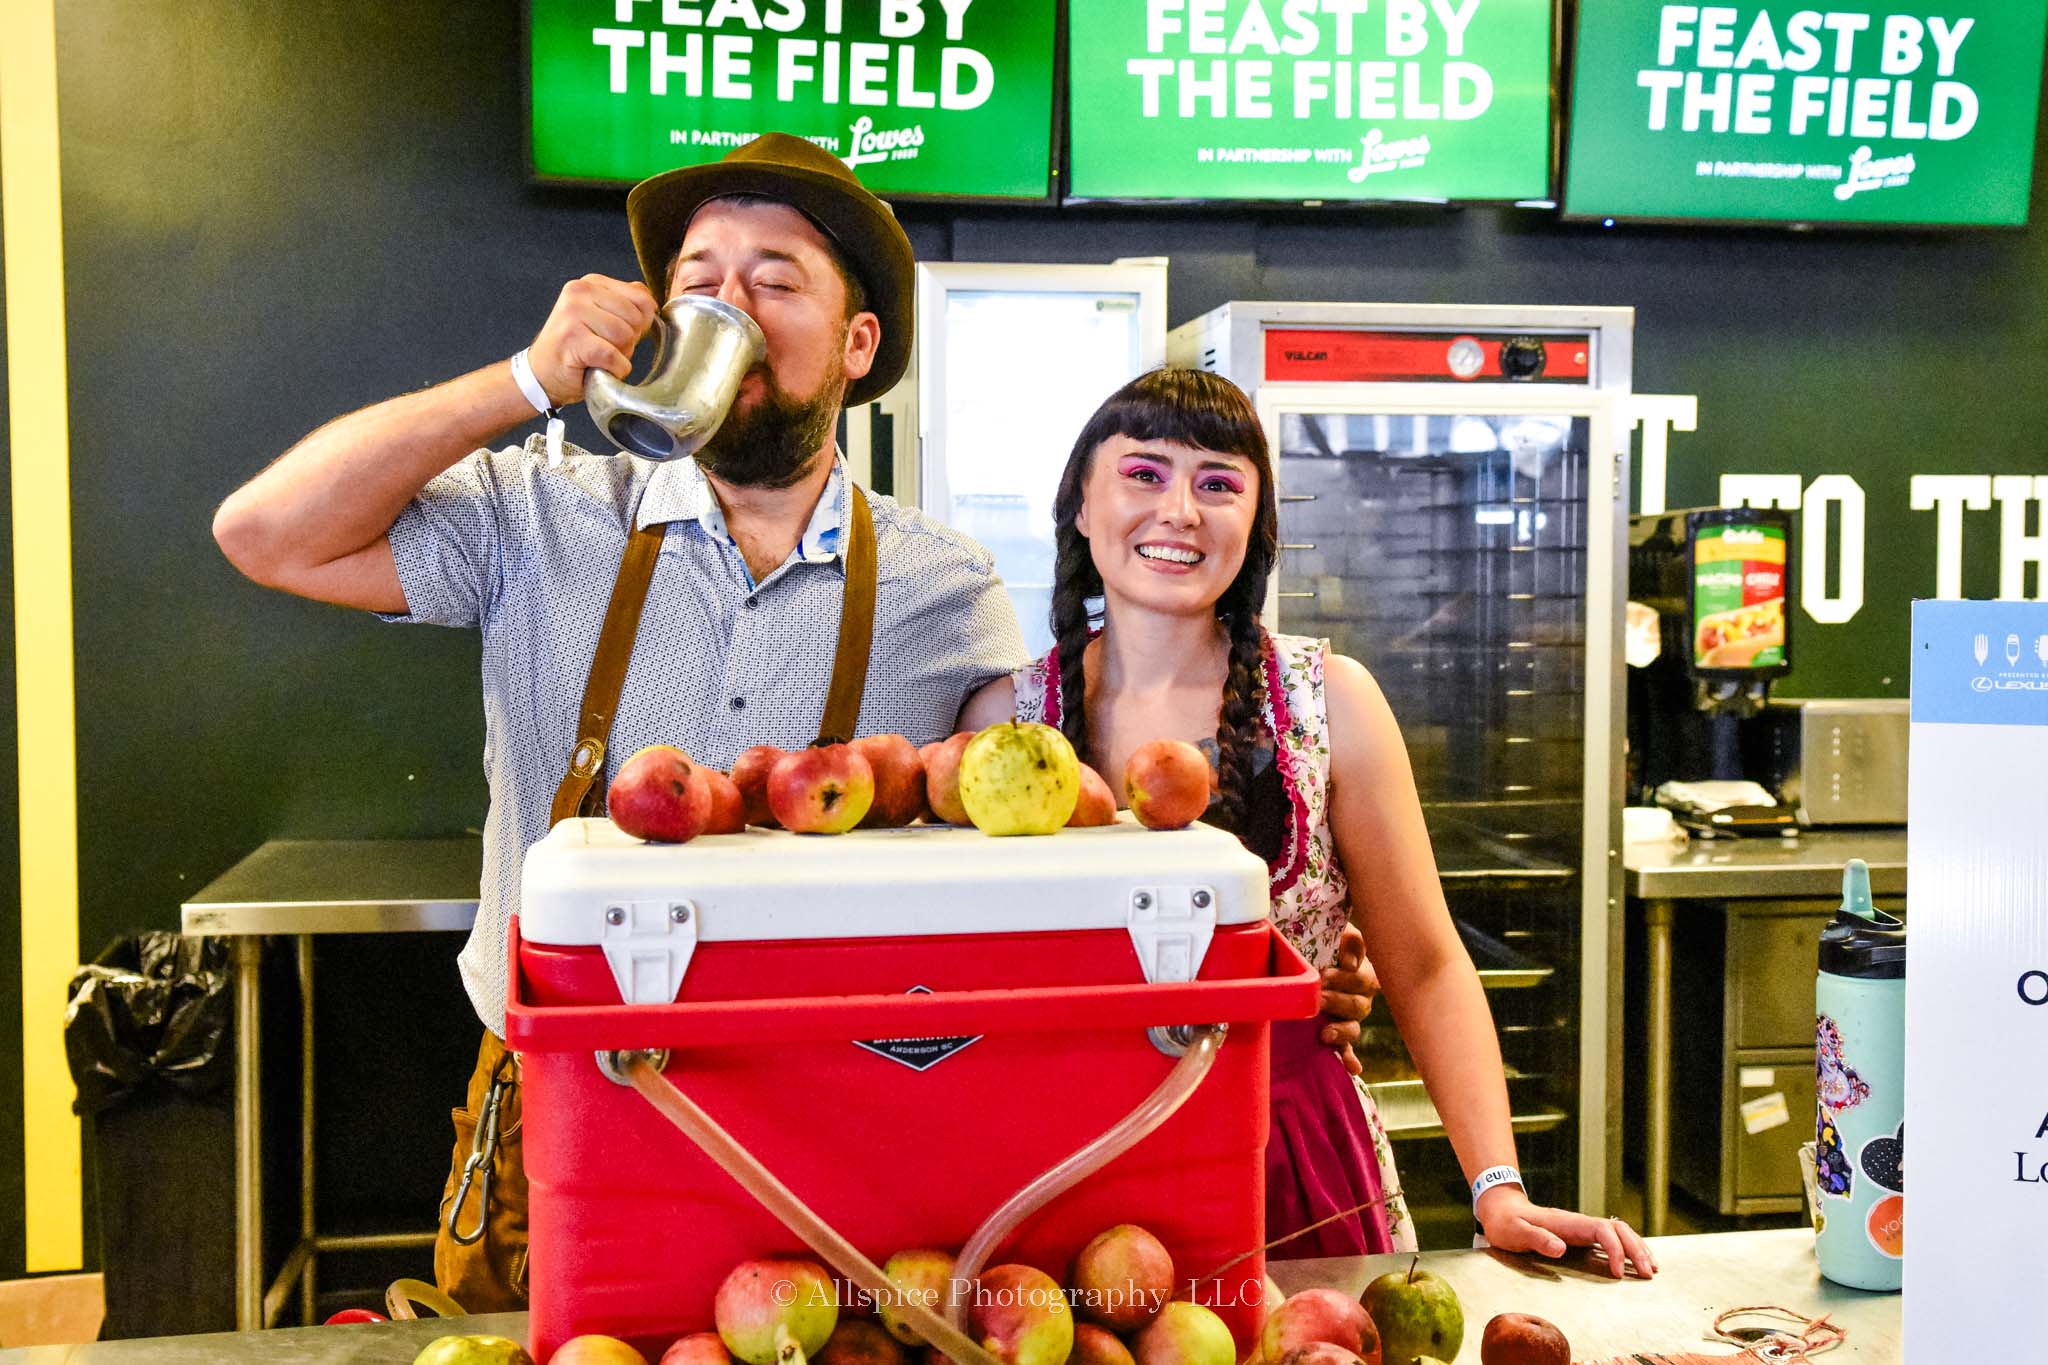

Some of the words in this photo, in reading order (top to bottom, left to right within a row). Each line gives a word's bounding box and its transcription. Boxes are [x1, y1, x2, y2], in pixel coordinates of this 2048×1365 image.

[1146, 0, 1369, 56] FEAST
[1385, 0, 1481, 57] BY
[1657, 5, 1871, 73] FEAST
[1880, 14, 1975, 77] BY
[592, 27, 753, 100] THE
[776, 38, 995, 111] FIELD
[1126, 58, 1273, 119] THE
[1293, 60, 1494, 121] FIELD
[1637, 69, 1776, 135] THE
[1788, 75, 1980, 142] FIELD
[670, 129, 687, 145] IN
[803, 134, 839, 152] ITH
[841, 115, 925, 171] Lowes
[1197, 147, 1214, 163] IN
[1314, 148, 1353, 163] WITH
[890, 1046, 938, 1054] ANDERSON
